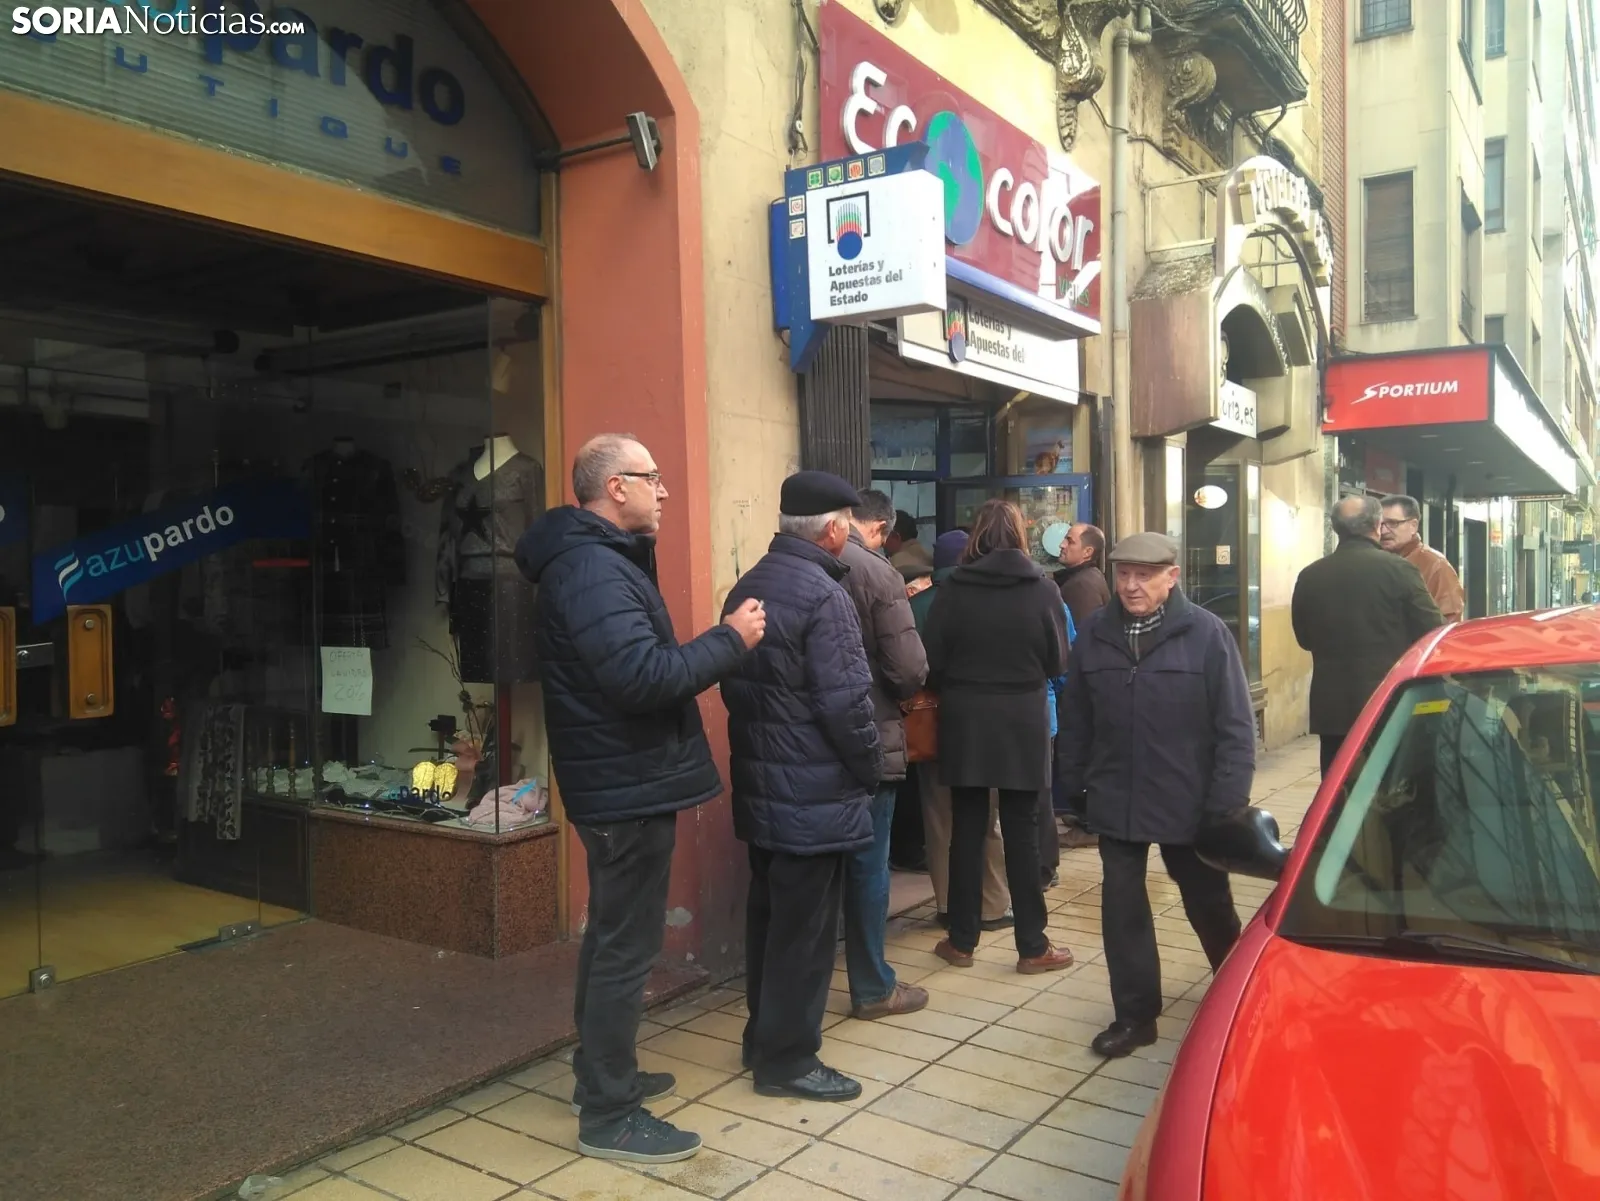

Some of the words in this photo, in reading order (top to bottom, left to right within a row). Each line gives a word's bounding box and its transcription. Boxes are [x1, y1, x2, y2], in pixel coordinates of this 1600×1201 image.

[132, 0, 465, 126] pardo
[28, 20, 462, 176] UTIQUE
[828, 260, 875, 277] Loterías
[877, 259, 885, 273] y
[830, 275, 882, 293] Apuestas
[885, 268, 903, 283] del
[829, 290, 869, 307] Estado
[970, 330, 1010, 360] Apuestas
[1350, 380, 1459, 405] SPORTIUM
[86, 505, 234, 577] azupardo
